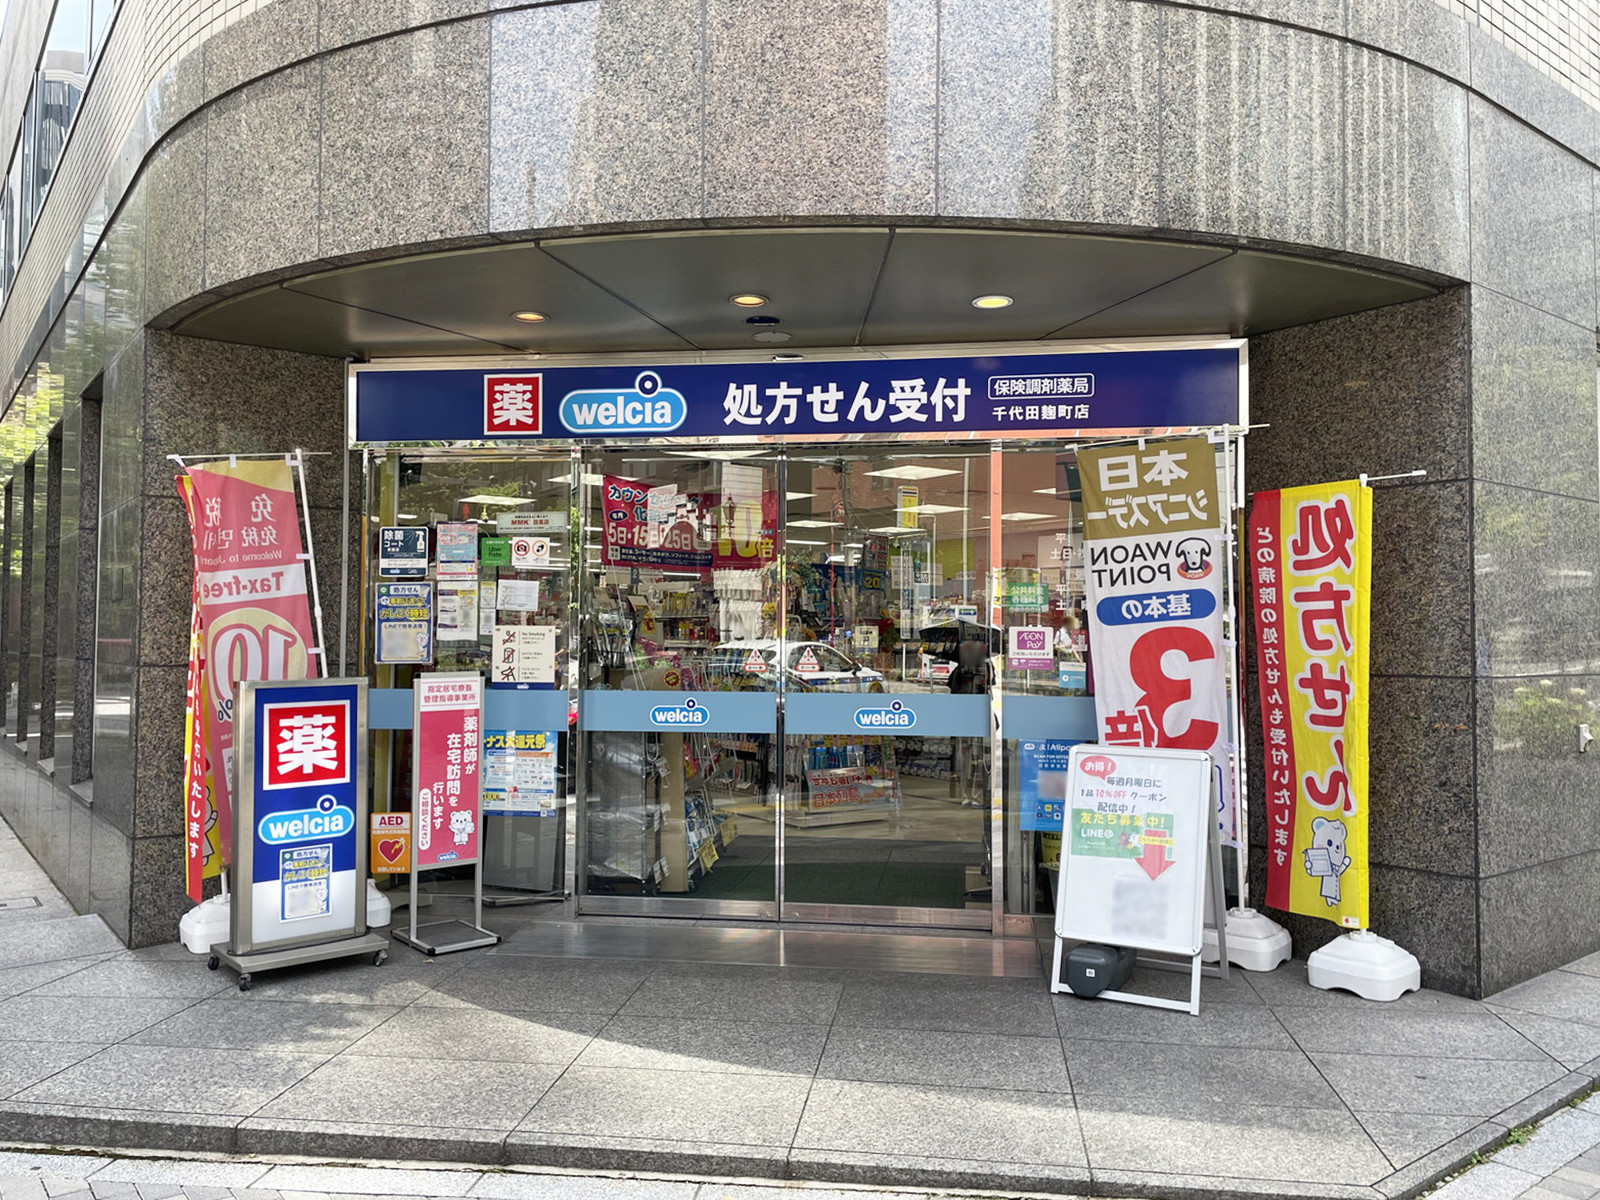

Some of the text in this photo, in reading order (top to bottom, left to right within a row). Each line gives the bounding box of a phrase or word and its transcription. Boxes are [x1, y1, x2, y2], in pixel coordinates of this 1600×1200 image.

[722, 376, 972, 427] 処方せん受付
[993, 377, 1090, 397] 保険調剤薬局
[492, 382, 535, 427] 薬
[572, 394, 672, 427] welcia
[654, 707, 703, 724] welcia
[858, 709, 909, 727] welcia
[275, 713, 339, 776] 薬
[463, 716, 478, 775] 薬剤師が
[483, 733, 546, 749] ナス大還元祭
[446, 733, 462, 807] 在宅訪問を
[1106, 776, 1162, 788] 毎週月曜日に
[432, 781, 445, 830] 行います
[268, 814, 344, 839] welcia
[379, 815, 404, 826] AED
